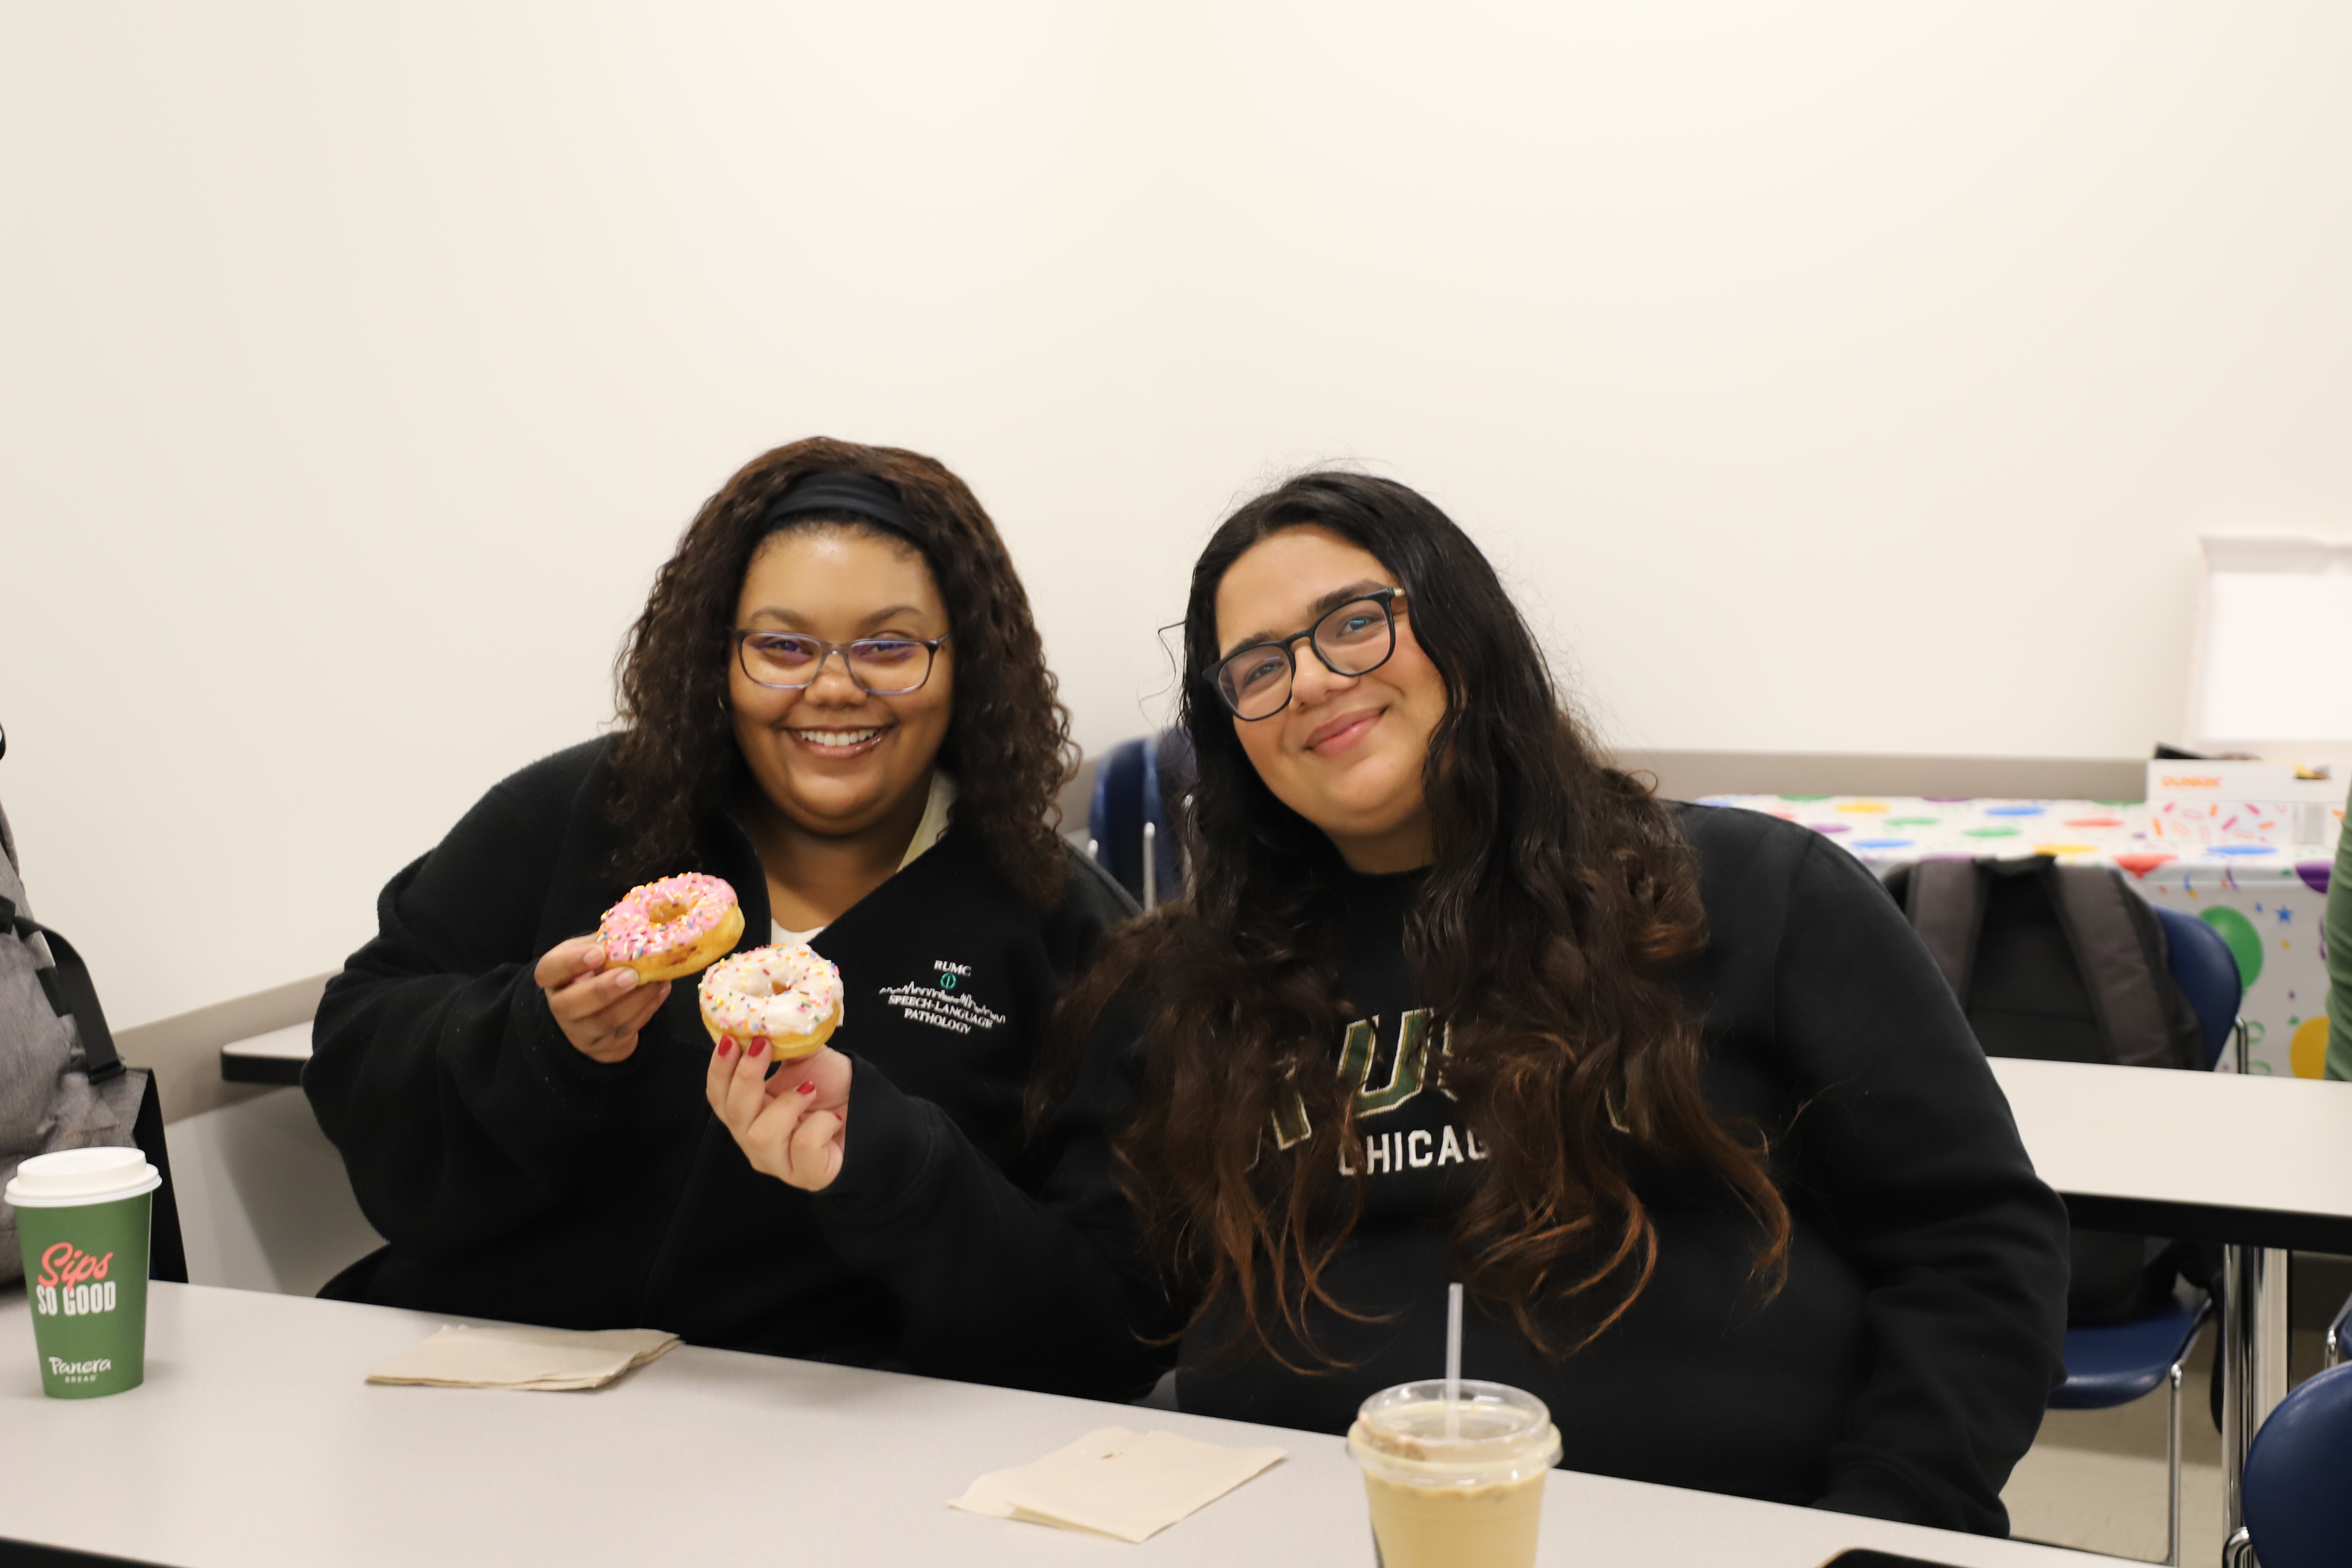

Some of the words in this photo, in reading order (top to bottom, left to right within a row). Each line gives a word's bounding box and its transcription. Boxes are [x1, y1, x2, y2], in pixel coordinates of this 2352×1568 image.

[934, 960, 971, 976] RUMC
[888, 994, 994, 1029] SPEECH-LANGUAGE
[904, 1008, 971, 1034] PATHOLOGY
[1338, 1124, 1489, 1176] HICA
[38, 1242, 114, 1294] Sips
[36, 1284, 58, 1316] SO
[62, 1280, 116, 1316] GOOD
[49, 1356, 111, 1375] Panera
